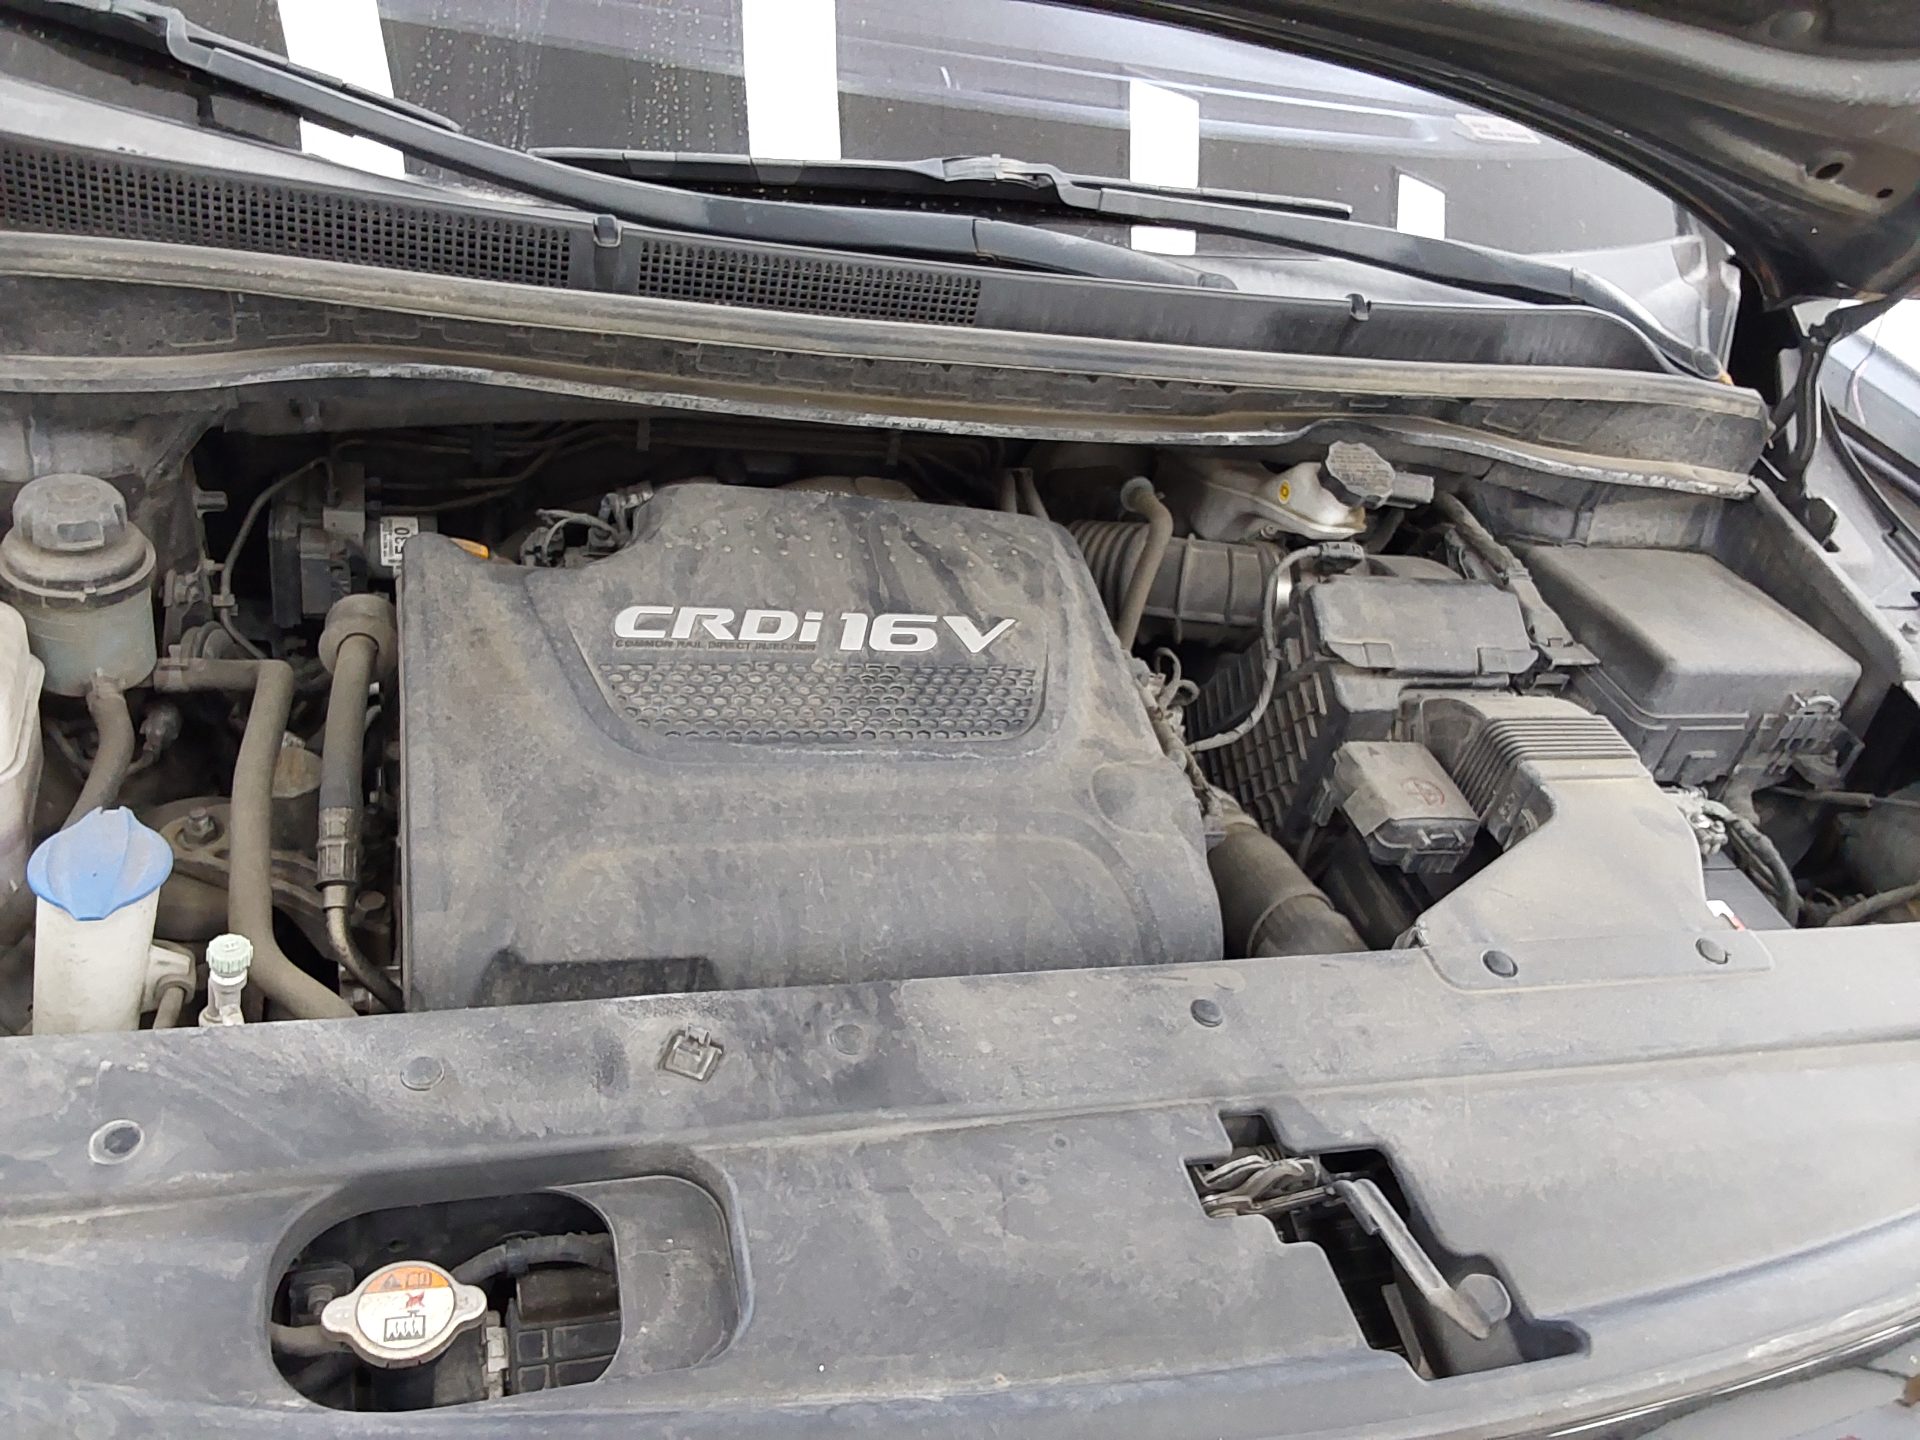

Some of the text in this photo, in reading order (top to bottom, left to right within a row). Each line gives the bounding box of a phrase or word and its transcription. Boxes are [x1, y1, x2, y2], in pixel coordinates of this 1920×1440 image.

[614, 605, 824, 642] CRDi
[615, 639, 817, 652] COMMON RAIL DIRECT INJECTION
